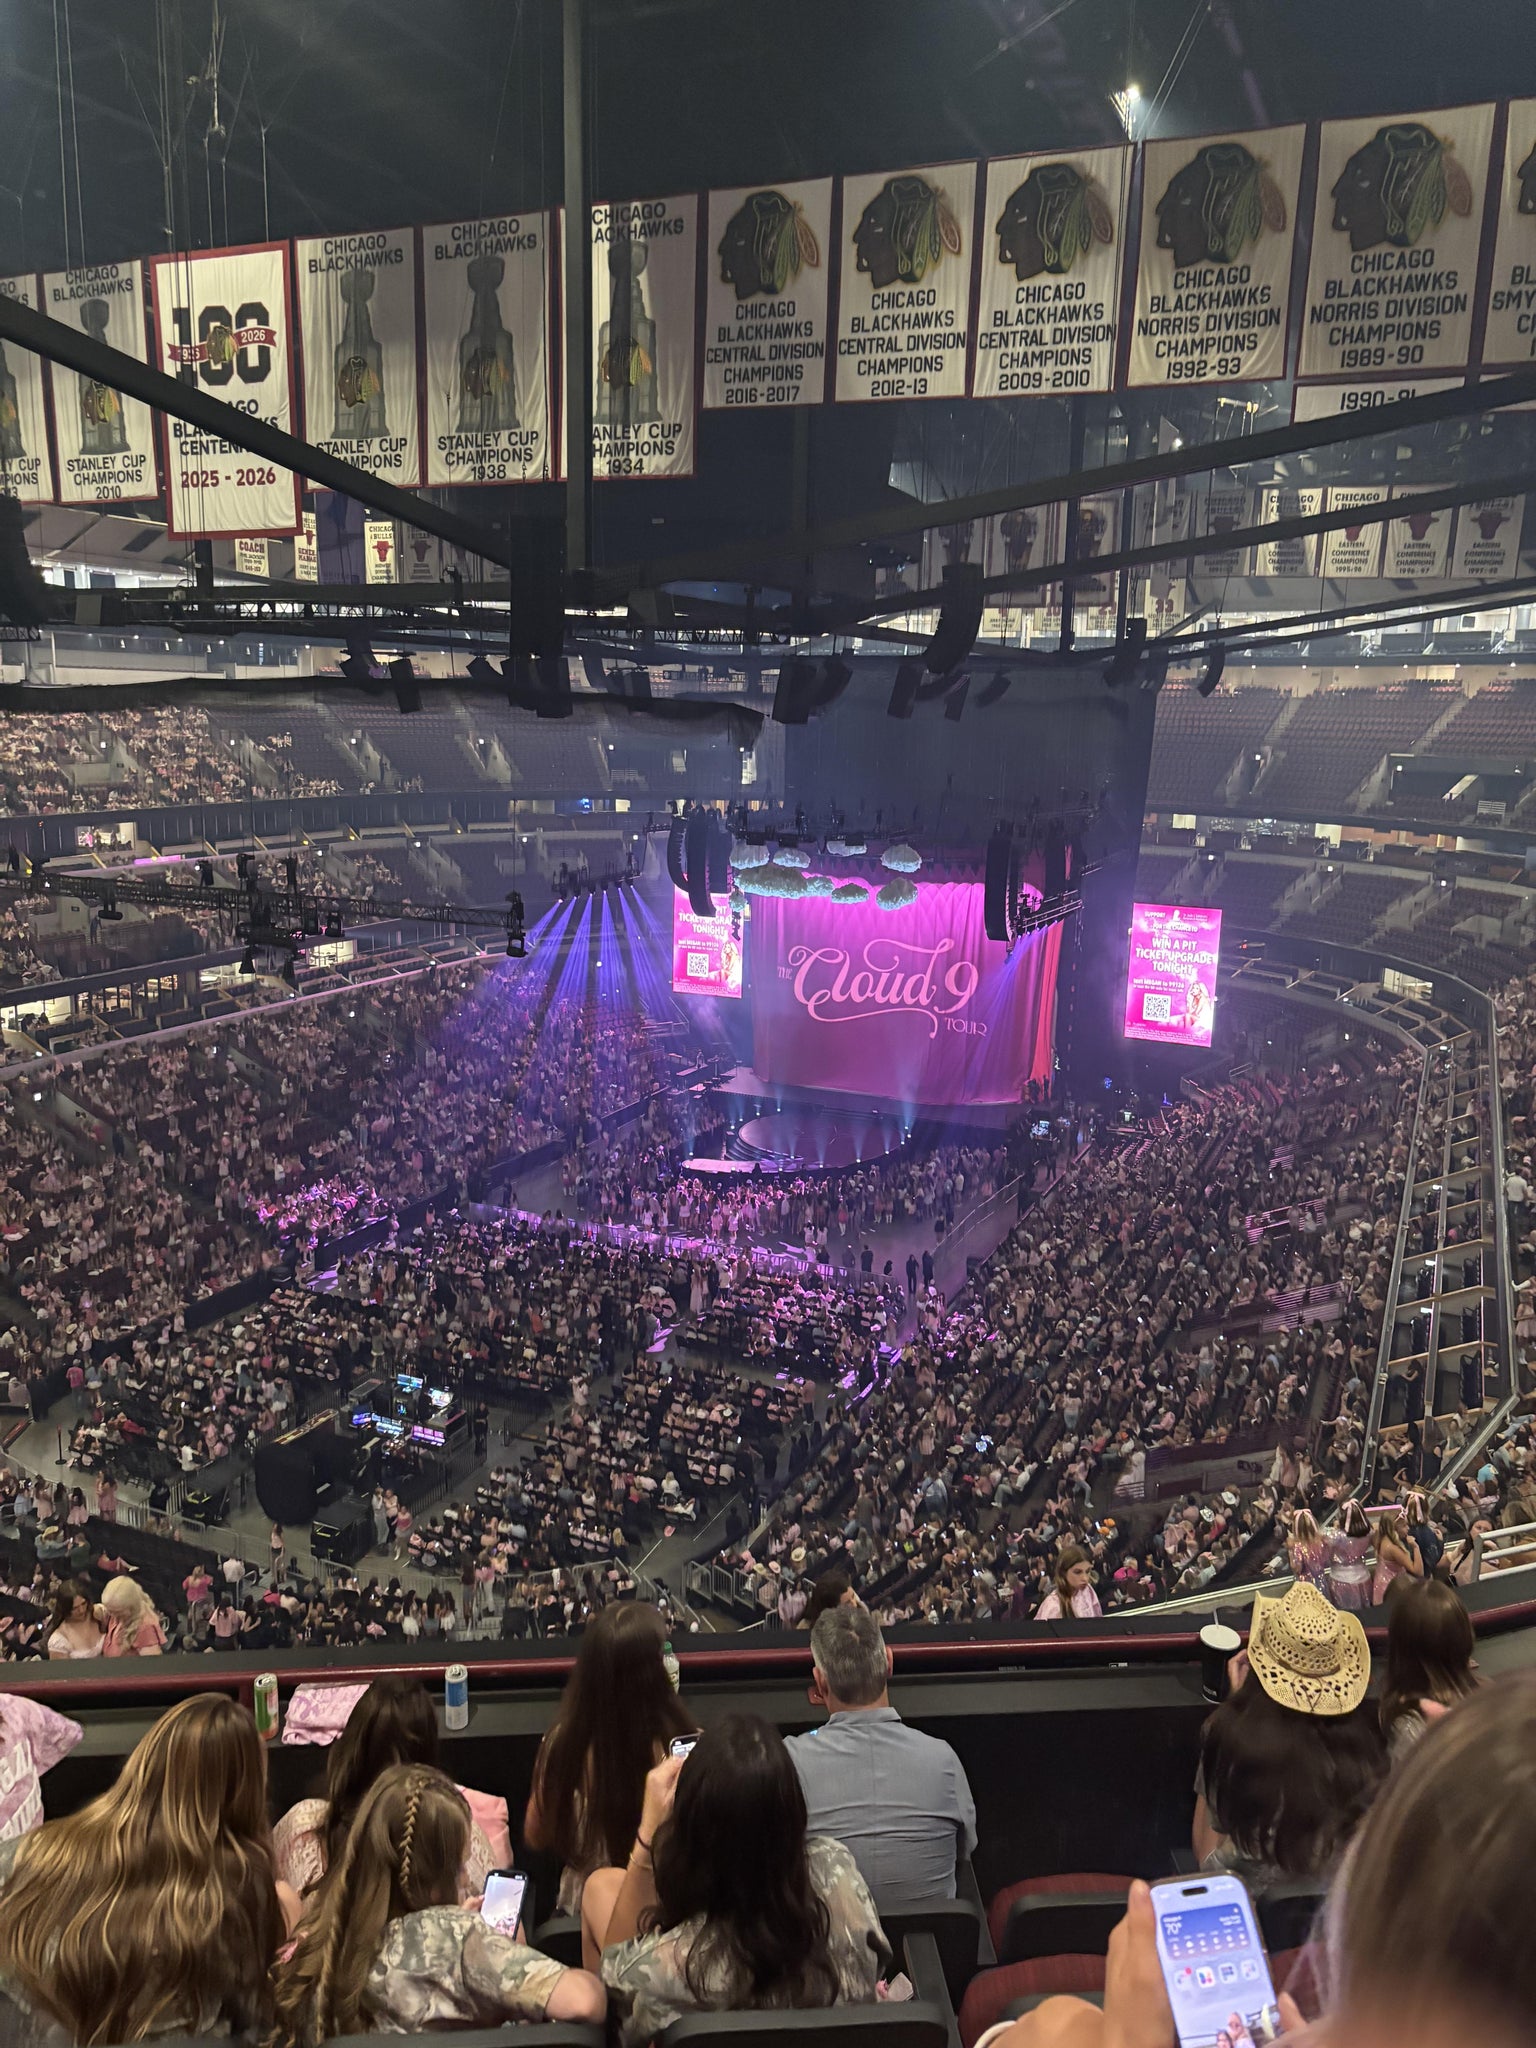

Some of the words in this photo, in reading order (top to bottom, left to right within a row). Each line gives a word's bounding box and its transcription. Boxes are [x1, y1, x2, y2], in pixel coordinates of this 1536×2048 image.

[592, 202, 666, 225] CHICAGO
[452, 219, 519, 242] CHICAGO
[594, 218, 684, 243] ACKHAWKS
[324, 235, 387, 255] CHICAGO
[434, 234, 537, 260] BLACKHAWKS
[308, 249, 403, 274] BLACKHAWKS
[1350, 249, 1434, 273] CHICAGO
[66, 265, 119, 284] CHICAGO
[1173, 266, 1251, 290] CHICAGO
[1325, 271, 1458, 299] BLACKHAWKS
[53, 279, 133, 302] BLACKHAWKS
[871, 289, 937, 310] CHICAGO
[1016, 282, 1086, 304] CHICAGO
[1149, 287, 1271, 314] BLACKHAWKS
[736, 301, 796, 320] CHICAGO
[993, 303, 1104, 328] BLACKHAWKS
[1310, 301, 1378, 324] NORRIS
[1385, 294, 1467, 320] DIVISION
[718, 321, 813, 342] BLACKHAWKS
[851, 311, 955, 333] BLACKHAWKS
[1137, 313, 1200, 337] NORRIS
[1205, 307, 1280, 332] DIVISION
[241, 329, 266, 343] 2026
[838, 335, 903, 355] CENTRAL
[907, 332, 966, 352] DIVISION
[979, 330, 1047, 350] CENTRAL
[1052, 323, 1117, 345] DIVISION
[1328, 321, 1441, 346] CHAMPIONS
[706, 344, 765, 363] CENTRAL
[769, 341, 824, 361] DIVISION
[1155, 334, 1258, 358] CHAMPIONS
[1340, 345, 1424, 368] 1989-90
[857, 356, 943, 376] CHAMPIONS
[999, 348, 1092, 370] CHAMPIONS
[1167, 358, 1241, 379] 1992-93
[723, 365, 804, 383] CHAMPIONS
[998, 370, 1090, 390] 2009-2010
[726, 385, 800, 404] 2016-2017
[871, 378, 928, 397] 2012-13
[438, 433, 500, 450] STANLEY
[506, 431, 539, 446] CUP
[592, 424, 641, 441] ANLEY
[649, 423, 682, 438] CUP
[379, 438, 407, 452] CUP
[592, 440, 675, 457] HAMPIONS
[18, 458, 41, 471] CUP
[67, 457, 118, 472] STANLEY
[123, 455, 146, 469] CUP
[445, 448, 533, 466] CHAMPIONS
[606, 458, 644, 474] 1934
[74, 470, 143, 486] CHAMPIONS
[181, 471, 220, 488] 2025
[236, 467, 276, 486] 2026
[471, 465, 506, 480] 1938
[96, 487, 122, 500] 2010
[1335, 493, 1380, 501] CHICAGO
[239, 541, 265, 553] COACH
[693, 924, 725, 936] TONIGHT
[1152, 938, 1171, 949] WIN
[1173, 940, 1180, 949] A
[1182, 941, 1197, 950] PIT
[1136, 947, 1166, 960] TICKET
[1168, 950, 1214, 965] UPGRADE
[1152, 960, 1193, 975] TONIGHT
[933, 961, 979, 1014] 9
[944, 1016, 988, 1037] TOUR
